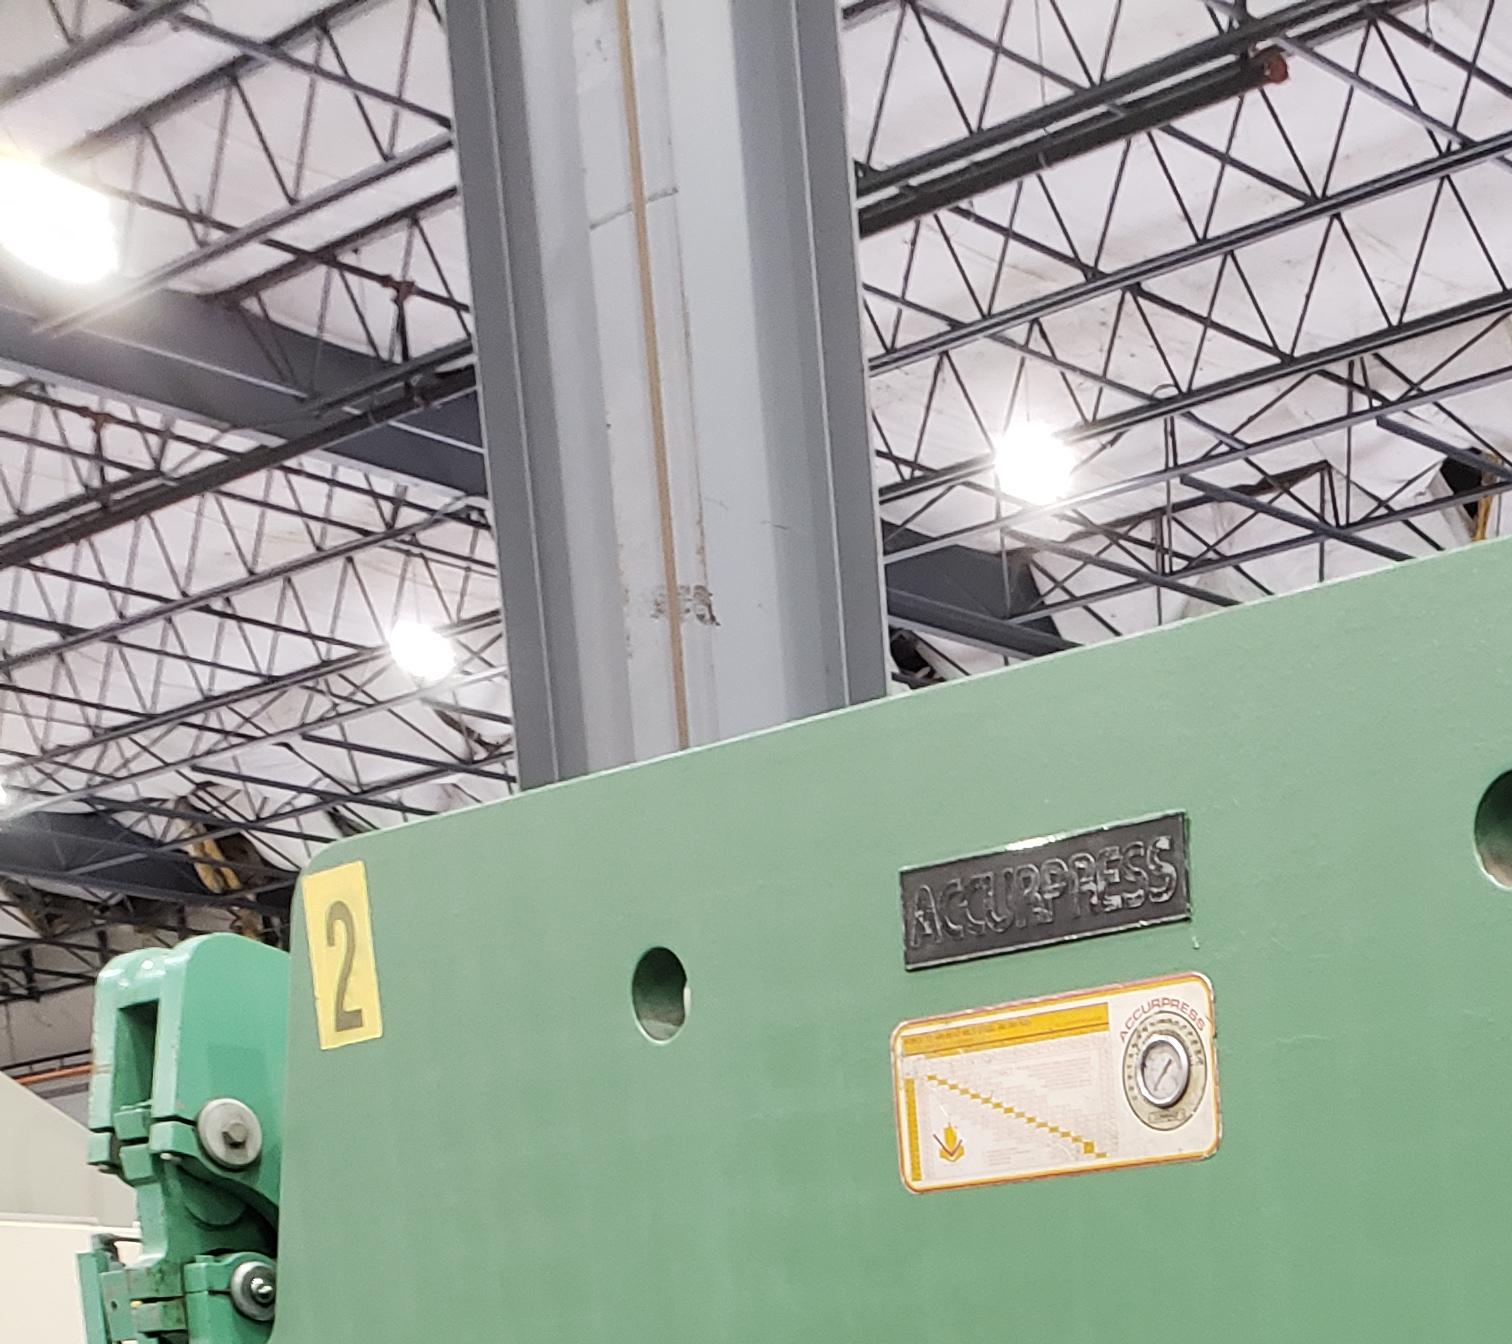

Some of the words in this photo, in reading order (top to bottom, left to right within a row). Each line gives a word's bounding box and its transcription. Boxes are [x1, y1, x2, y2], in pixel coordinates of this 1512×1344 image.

[910, 836, 1177, 947] ACCURPRESS
[326, 900, 363, 1032] 2
[1120, 998, 1205, 1042] ACCURPRESS
